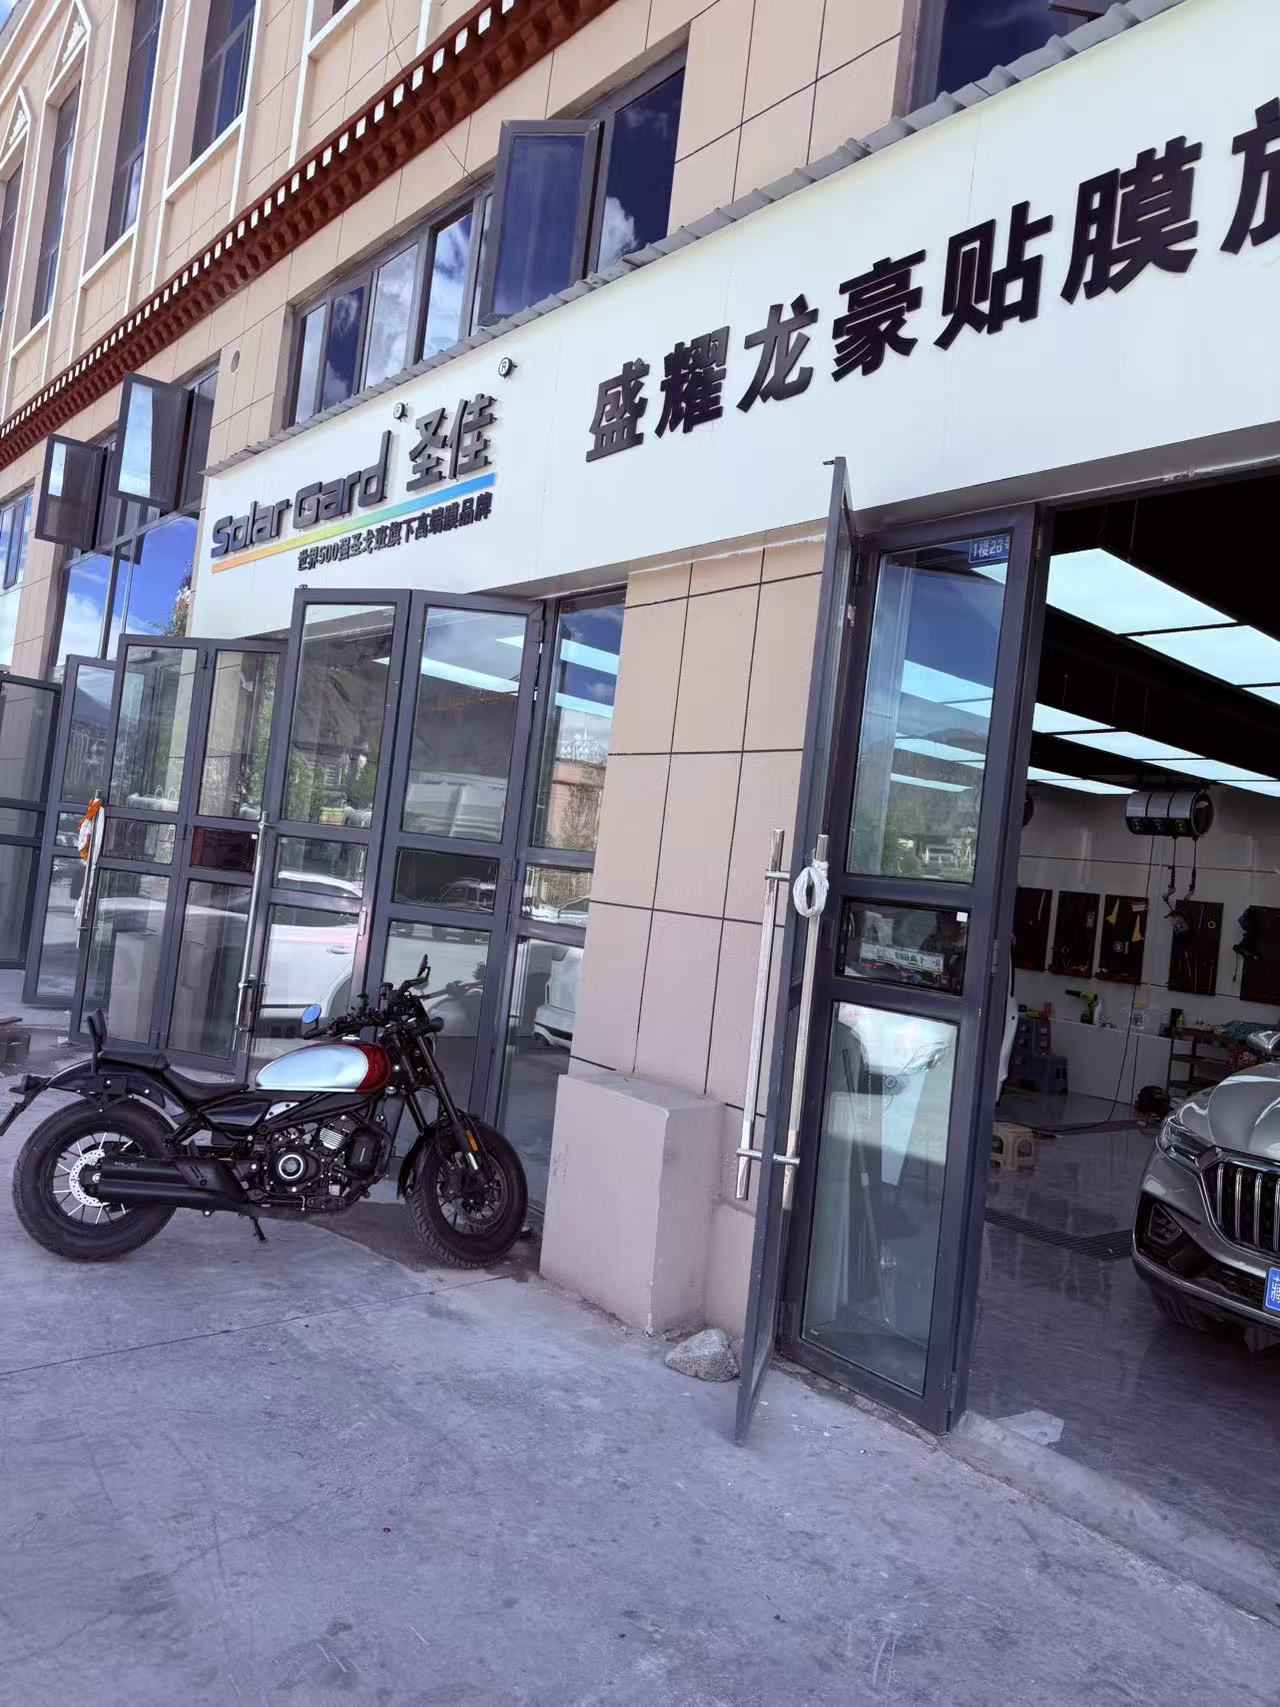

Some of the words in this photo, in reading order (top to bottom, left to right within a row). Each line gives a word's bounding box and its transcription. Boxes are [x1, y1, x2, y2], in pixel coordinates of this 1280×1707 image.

[211, 499, 290, 558] Solar
[293, 430, 391, 529] Gard
[406, 393, 497, 491] 圣佳
